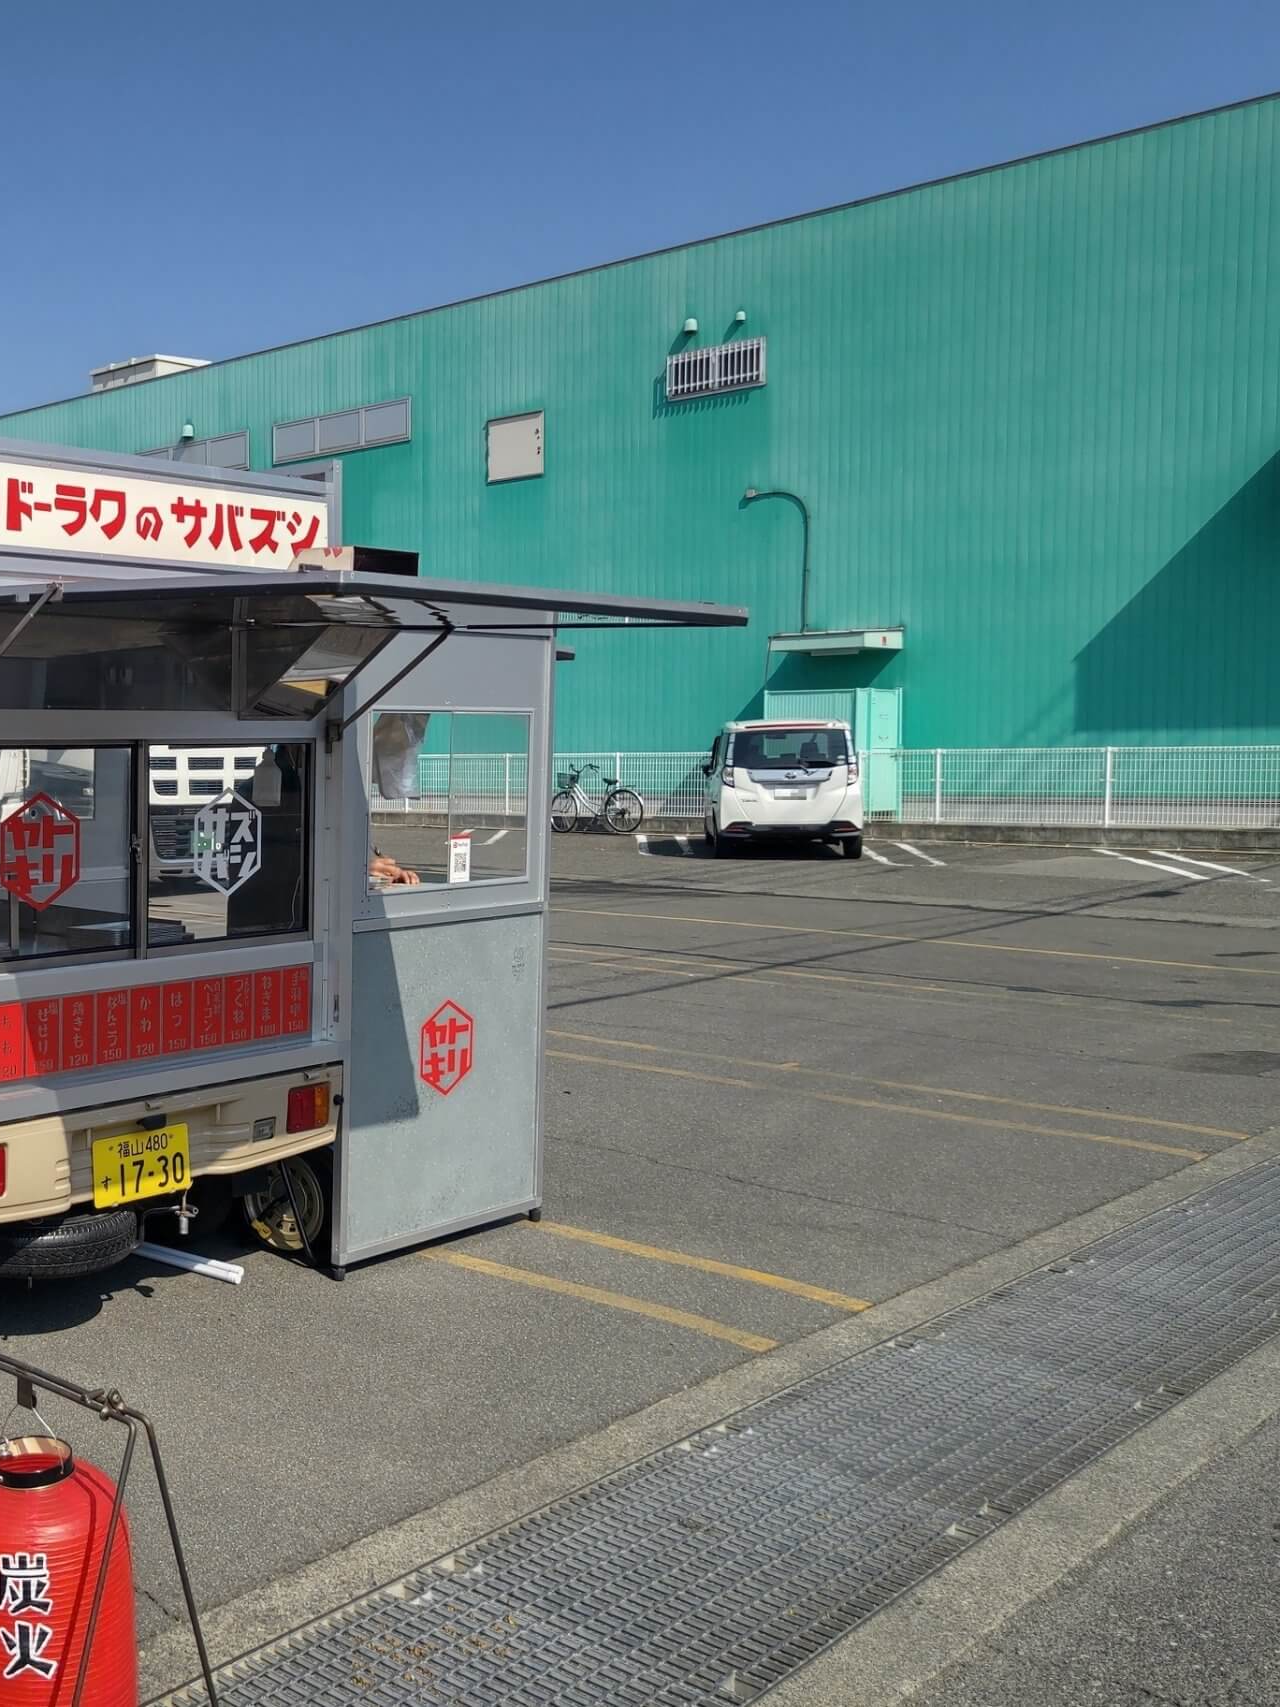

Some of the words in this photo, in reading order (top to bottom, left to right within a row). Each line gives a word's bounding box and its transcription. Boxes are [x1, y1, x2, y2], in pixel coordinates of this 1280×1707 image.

[6, 477, 321, 557] ドーラクのサバズシ
[120, 1152, 185, 1197] 17-30
